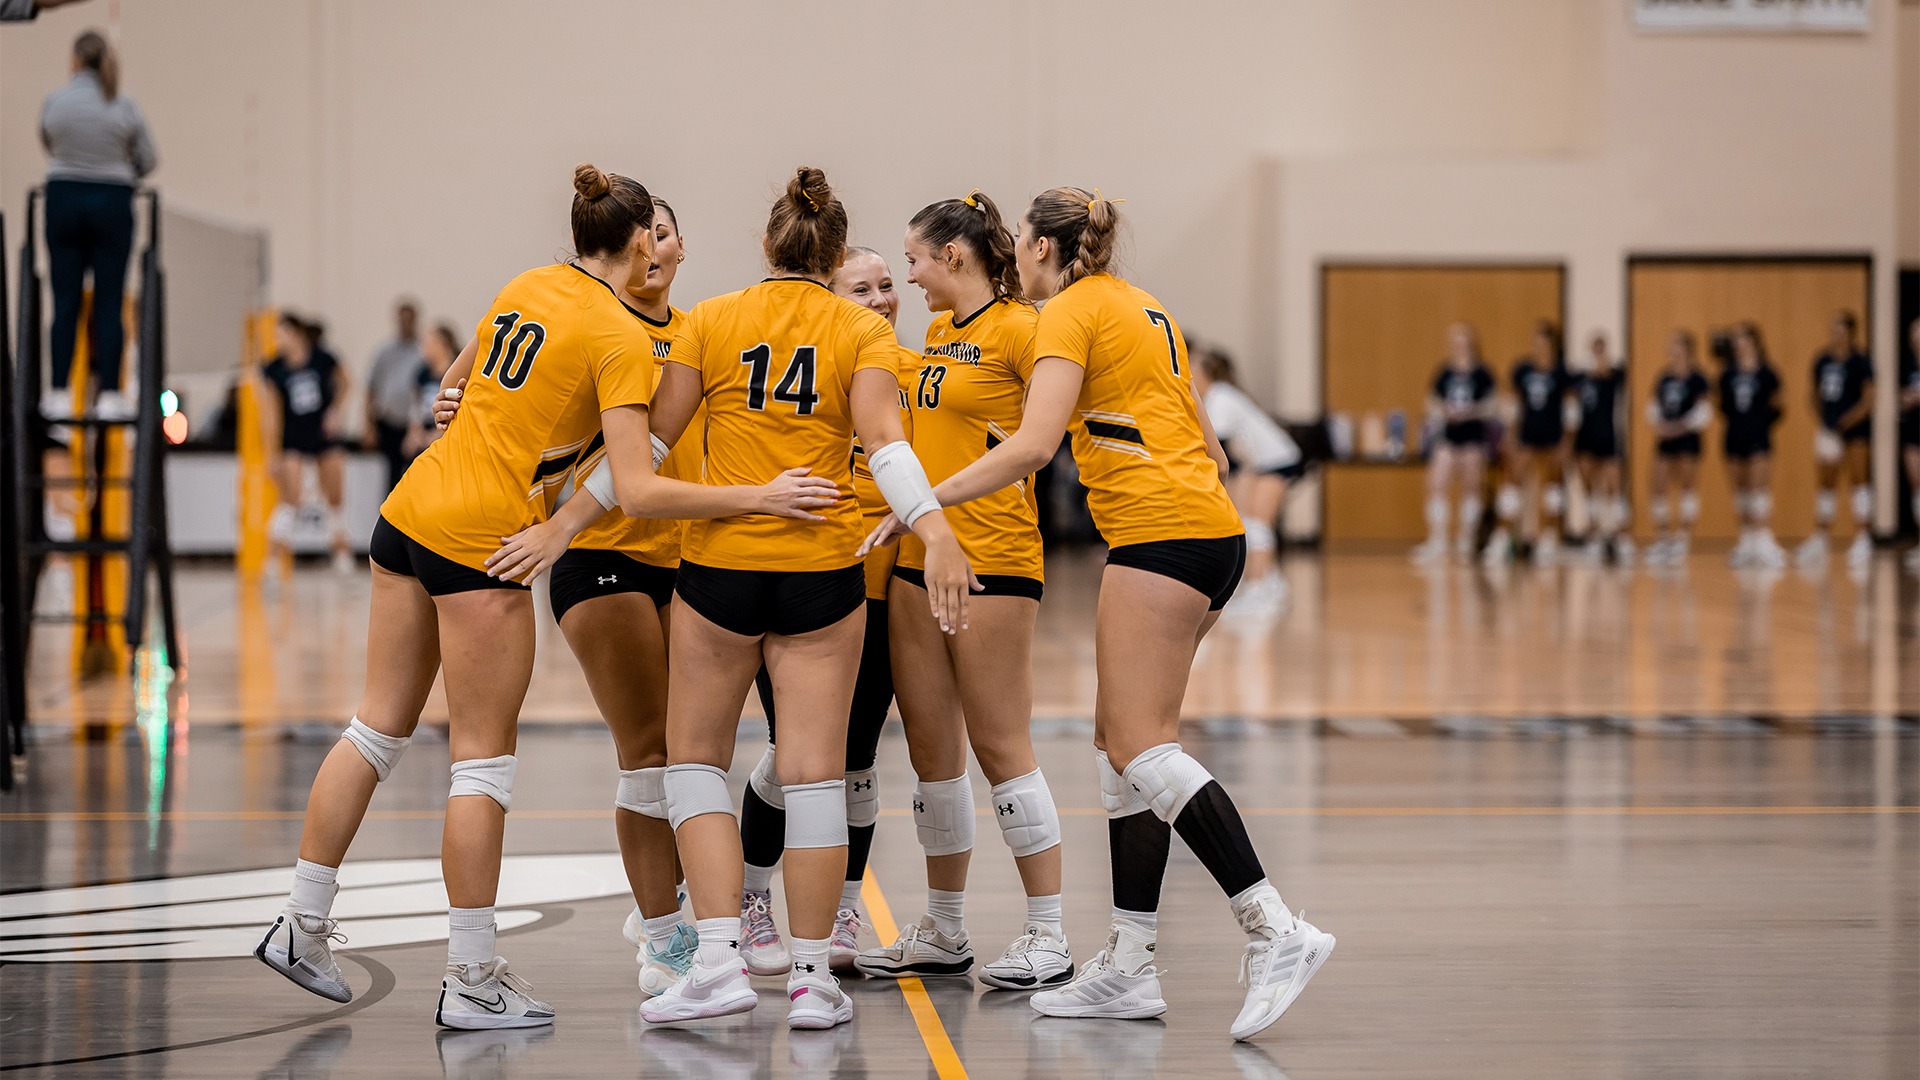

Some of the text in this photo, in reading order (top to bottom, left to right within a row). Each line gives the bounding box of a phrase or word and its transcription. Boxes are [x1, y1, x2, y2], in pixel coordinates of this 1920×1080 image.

[481, 310, 547, 391] 10
[1142, 306, 1180, 378] 7
[740, 342, 819, 416] 14
[916, 364, 948, 411] 13
